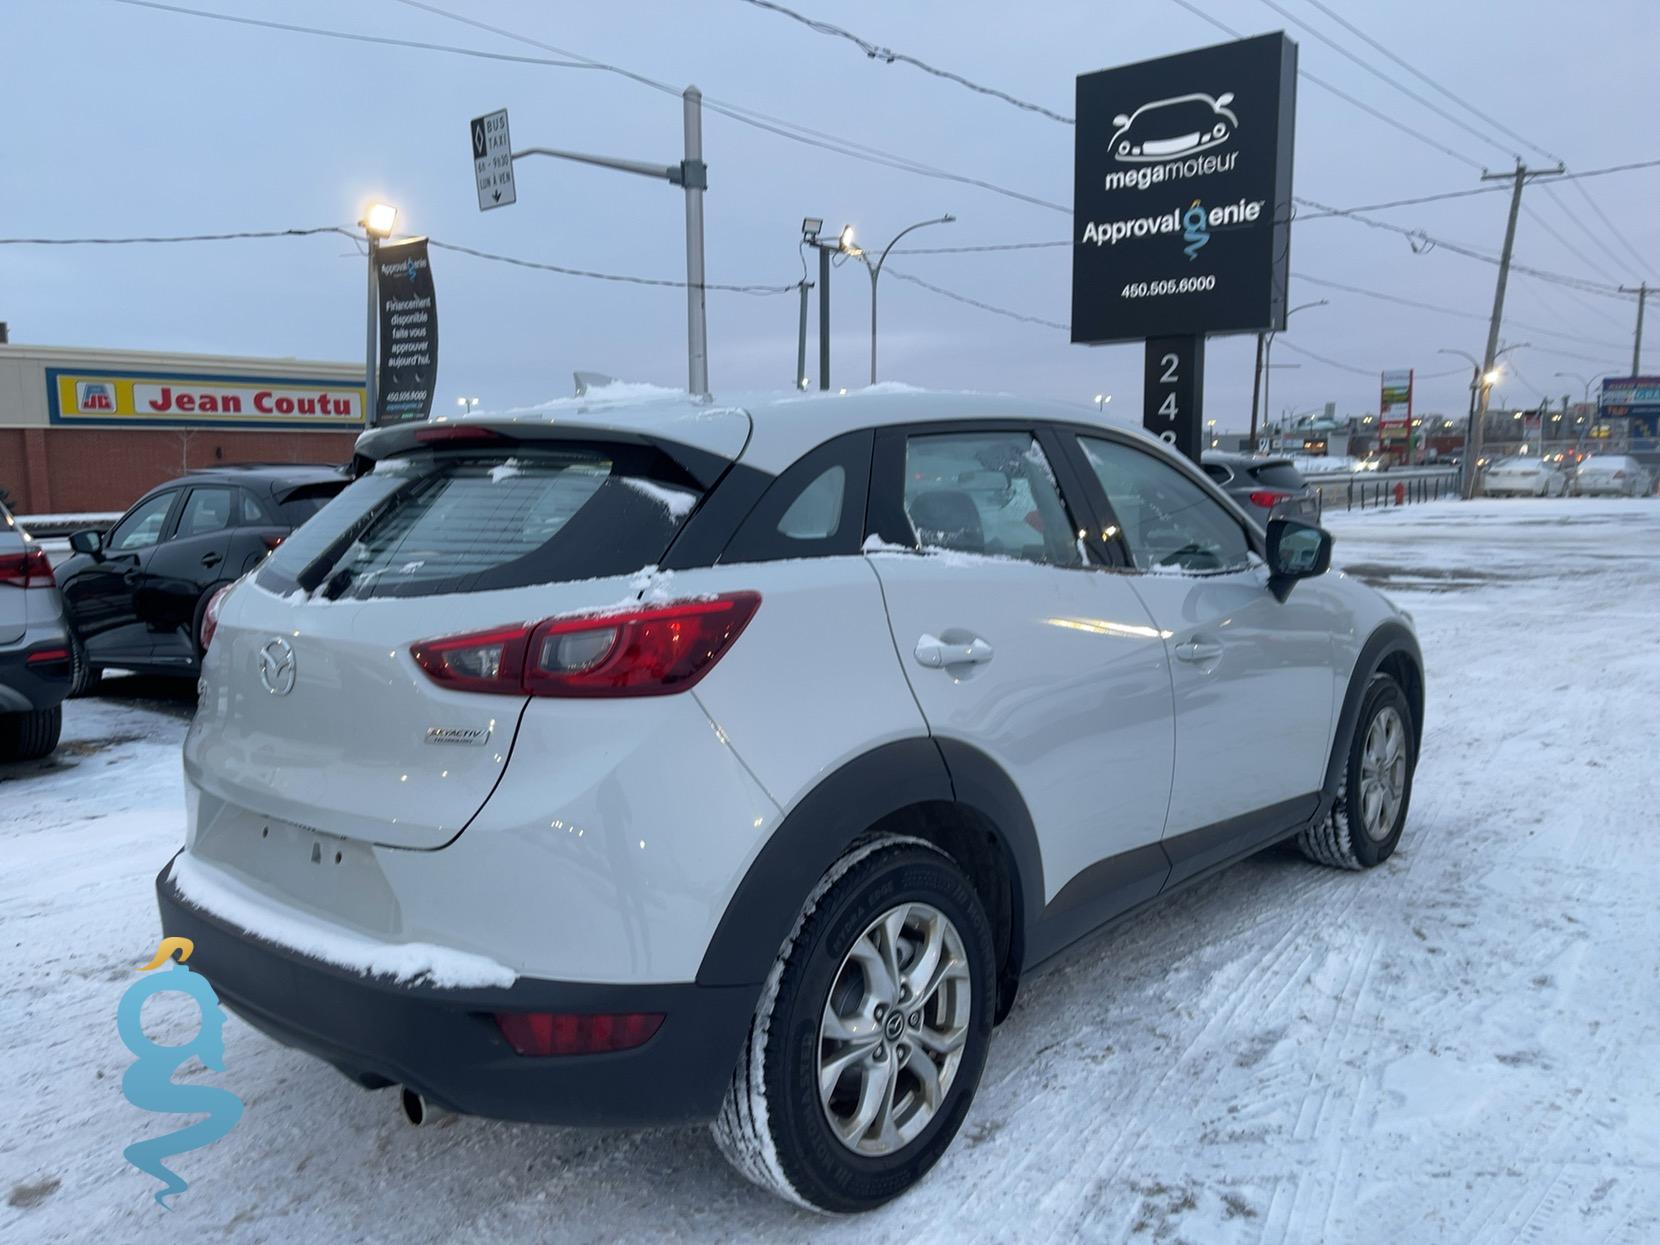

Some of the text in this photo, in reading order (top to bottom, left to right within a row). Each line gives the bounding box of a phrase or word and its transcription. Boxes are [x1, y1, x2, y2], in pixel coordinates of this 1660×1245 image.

[487, 117, 505, 133] BUS
[488, 133, 507, 150] TAXI
[1105, 151, 1239, 191] megamoteur
[1121, 275, 1216, 299] 450.505.6000
[386, 296, 431, 312] Financement
[391, 311, 428, 326] disponible
[409, 327, 427, 338] vous
[391, 341, 429, 354] approuver
[149, 387, 352, 416] Jean Coutu
